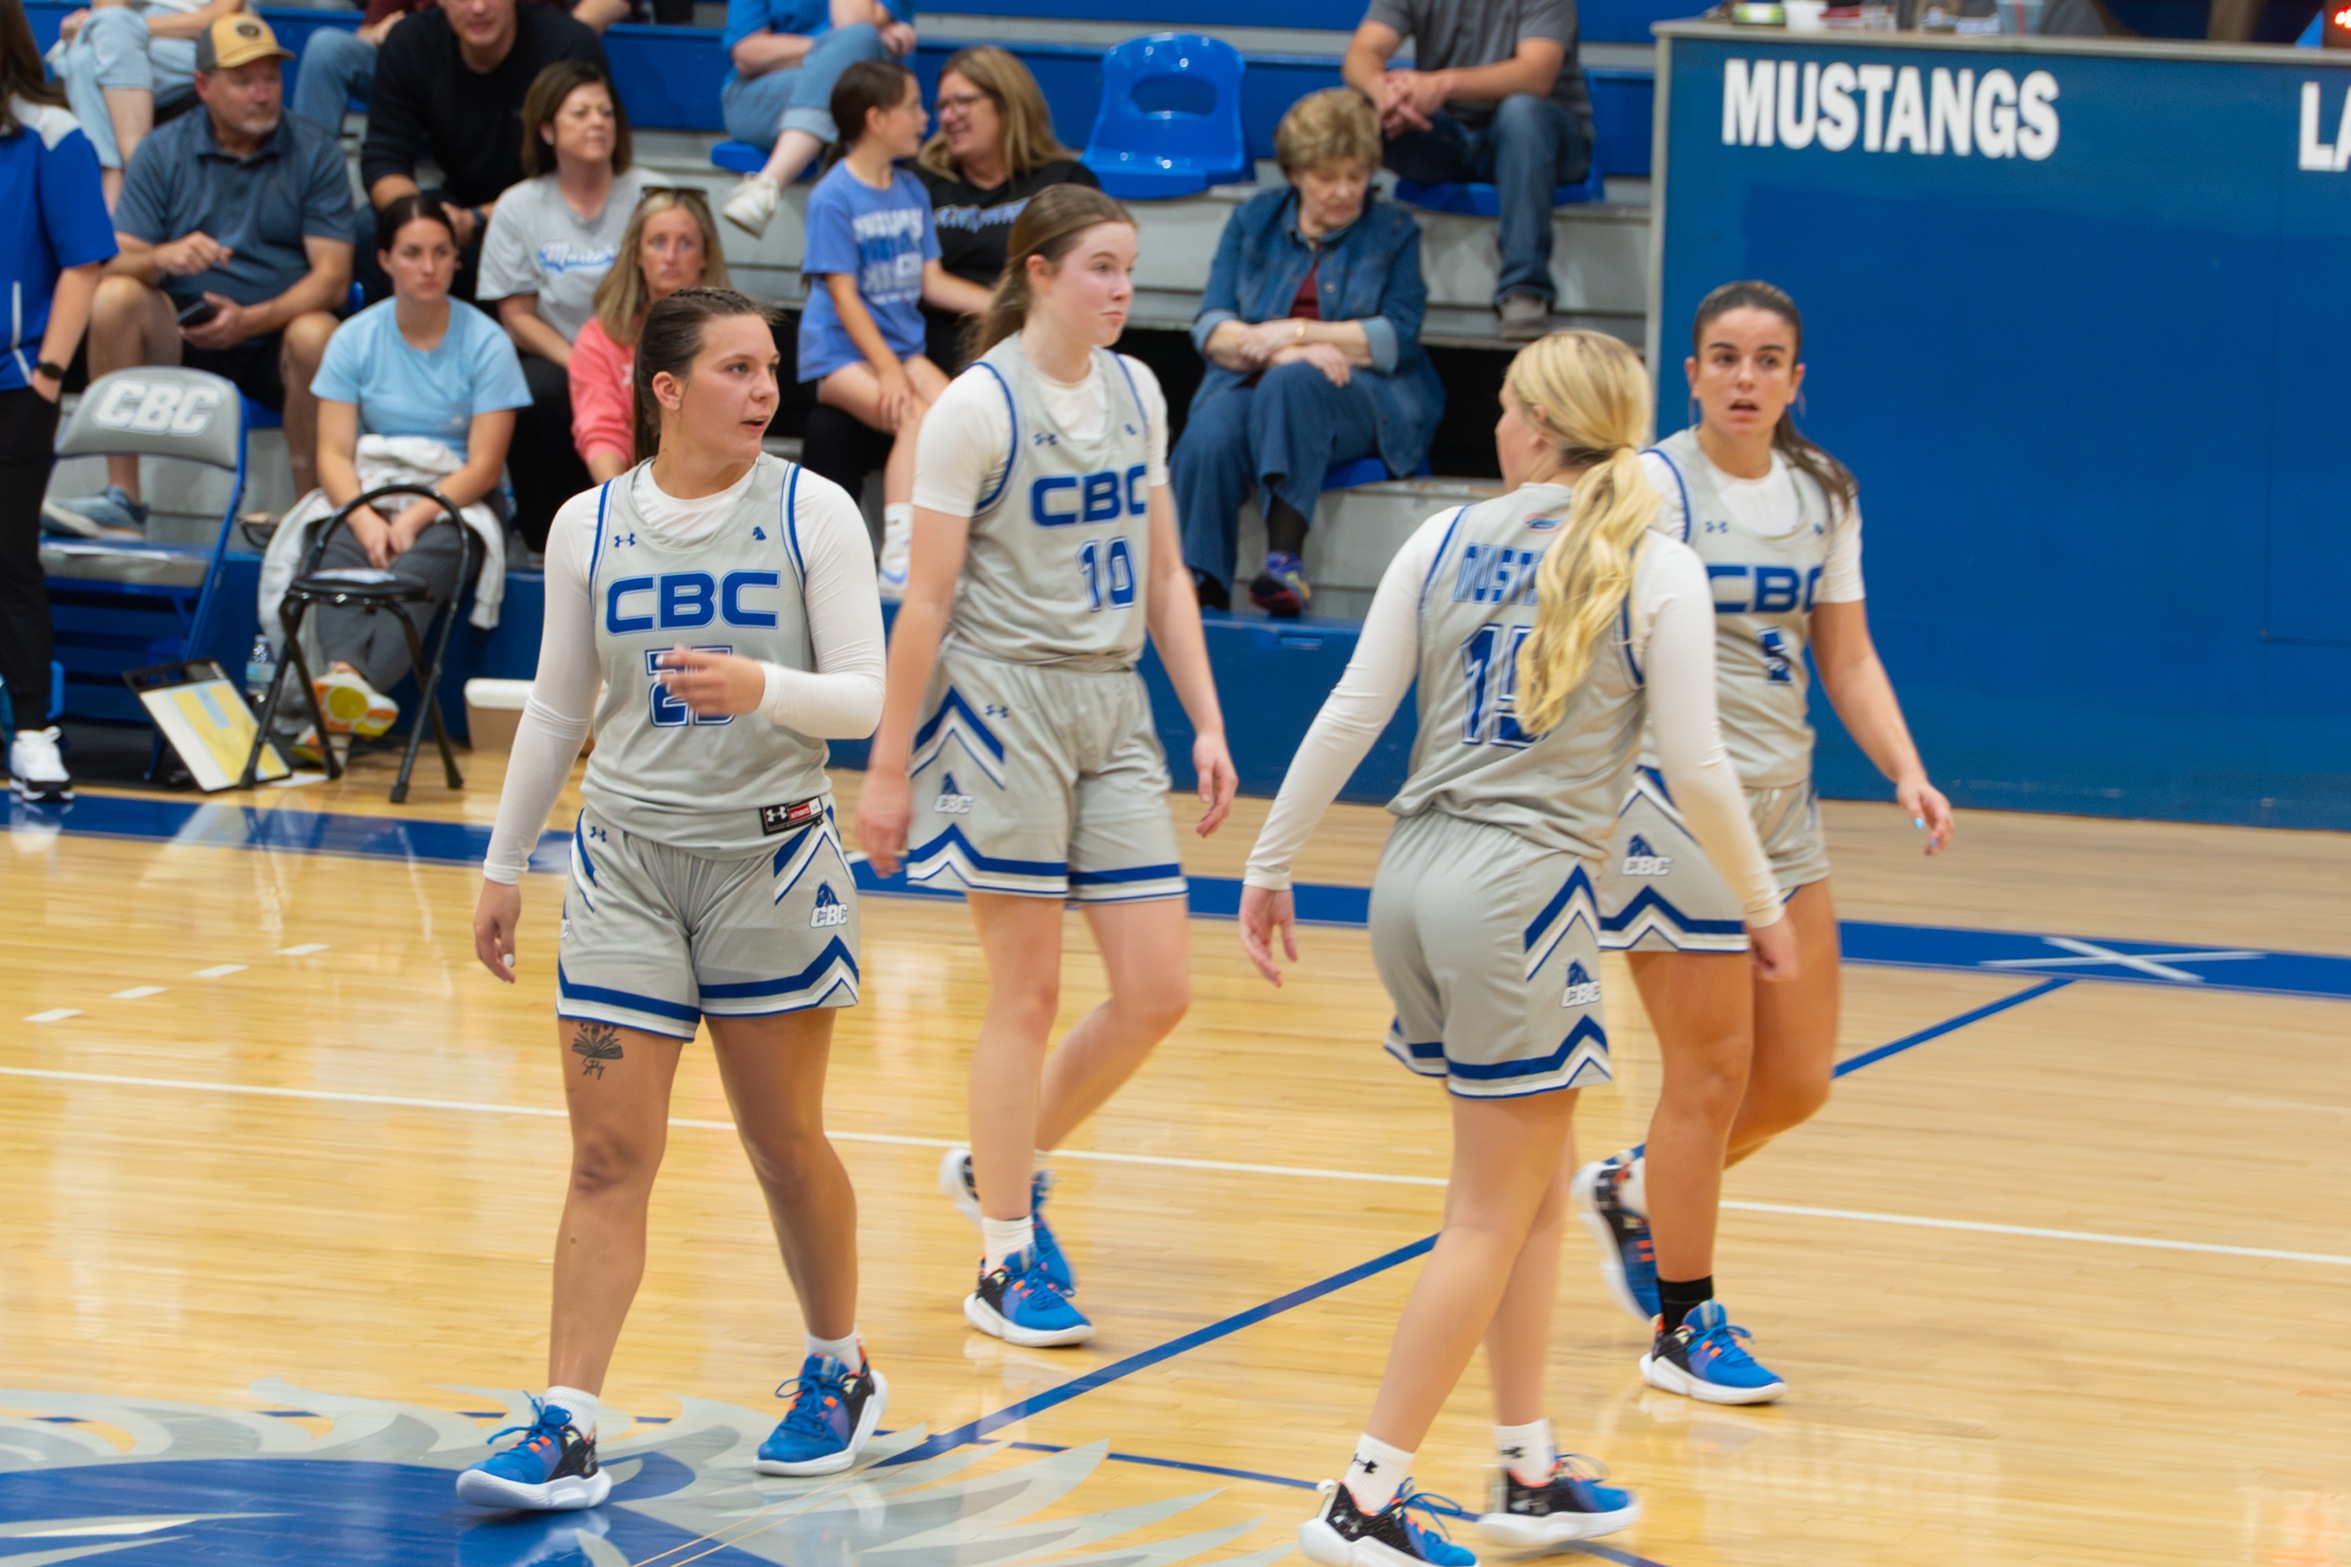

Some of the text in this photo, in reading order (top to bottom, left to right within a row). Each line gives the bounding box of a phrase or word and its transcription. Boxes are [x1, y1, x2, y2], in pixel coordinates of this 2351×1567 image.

[1721, 58, 2061, 161] MUSTANGS
[95, 379, 222, 437] CBC
[1030, 463, 1147, 528] CBC
[606, 569, 780, 636] CBC
[1076, 536, 1136, 612] 10
[1621, 855, 1675, 877] CBC
[809, 903, 848, 928] CBC
